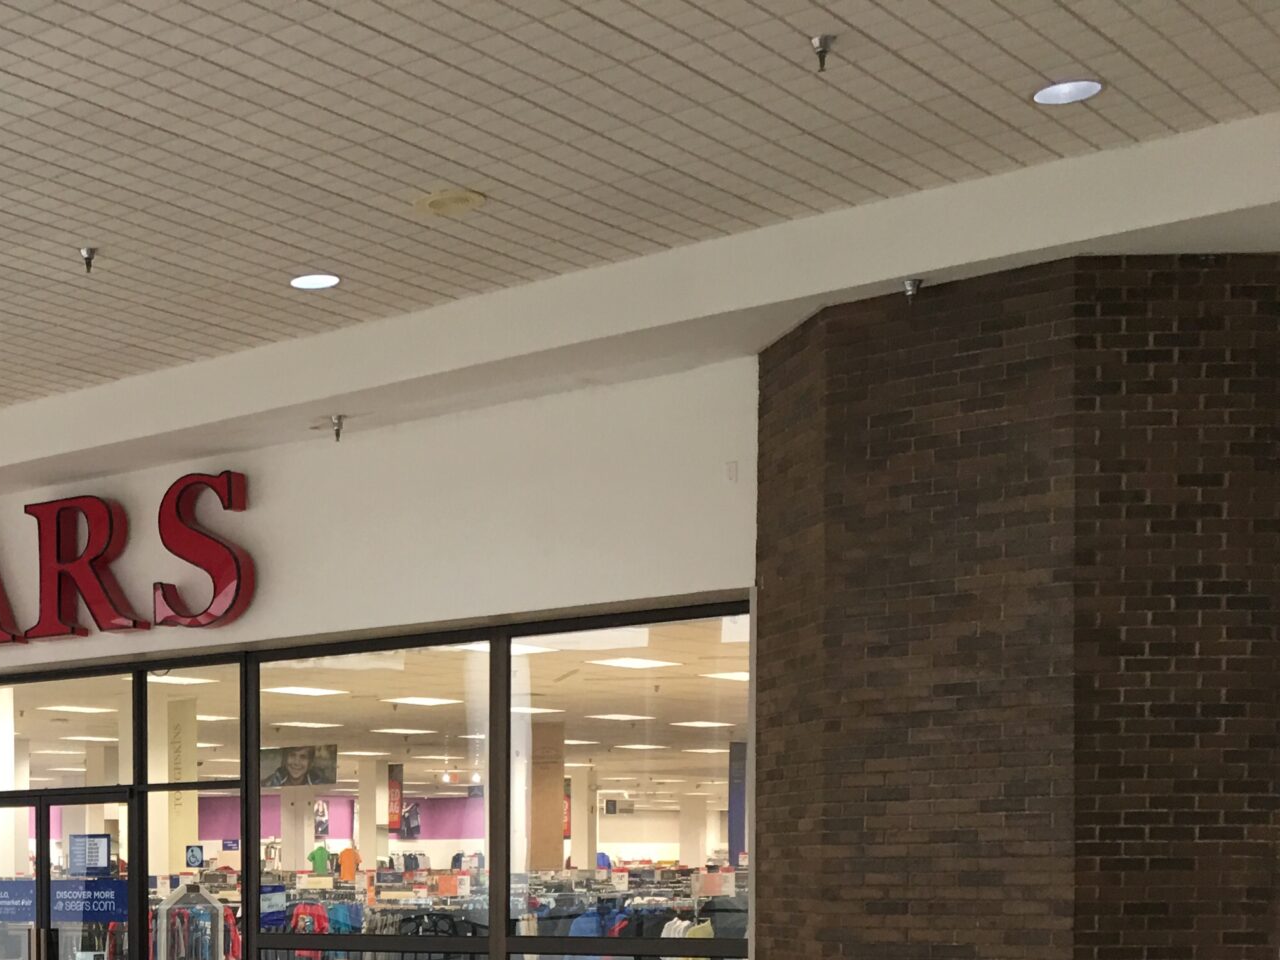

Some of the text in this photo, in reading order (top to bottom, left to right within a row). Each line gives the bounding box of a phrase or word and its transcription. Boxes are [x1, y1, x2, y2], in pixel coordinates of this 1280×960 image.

[171, 722, 183, 808] TOGHSKINS
[56, 890, 115, 899] DISCOVER MORE
